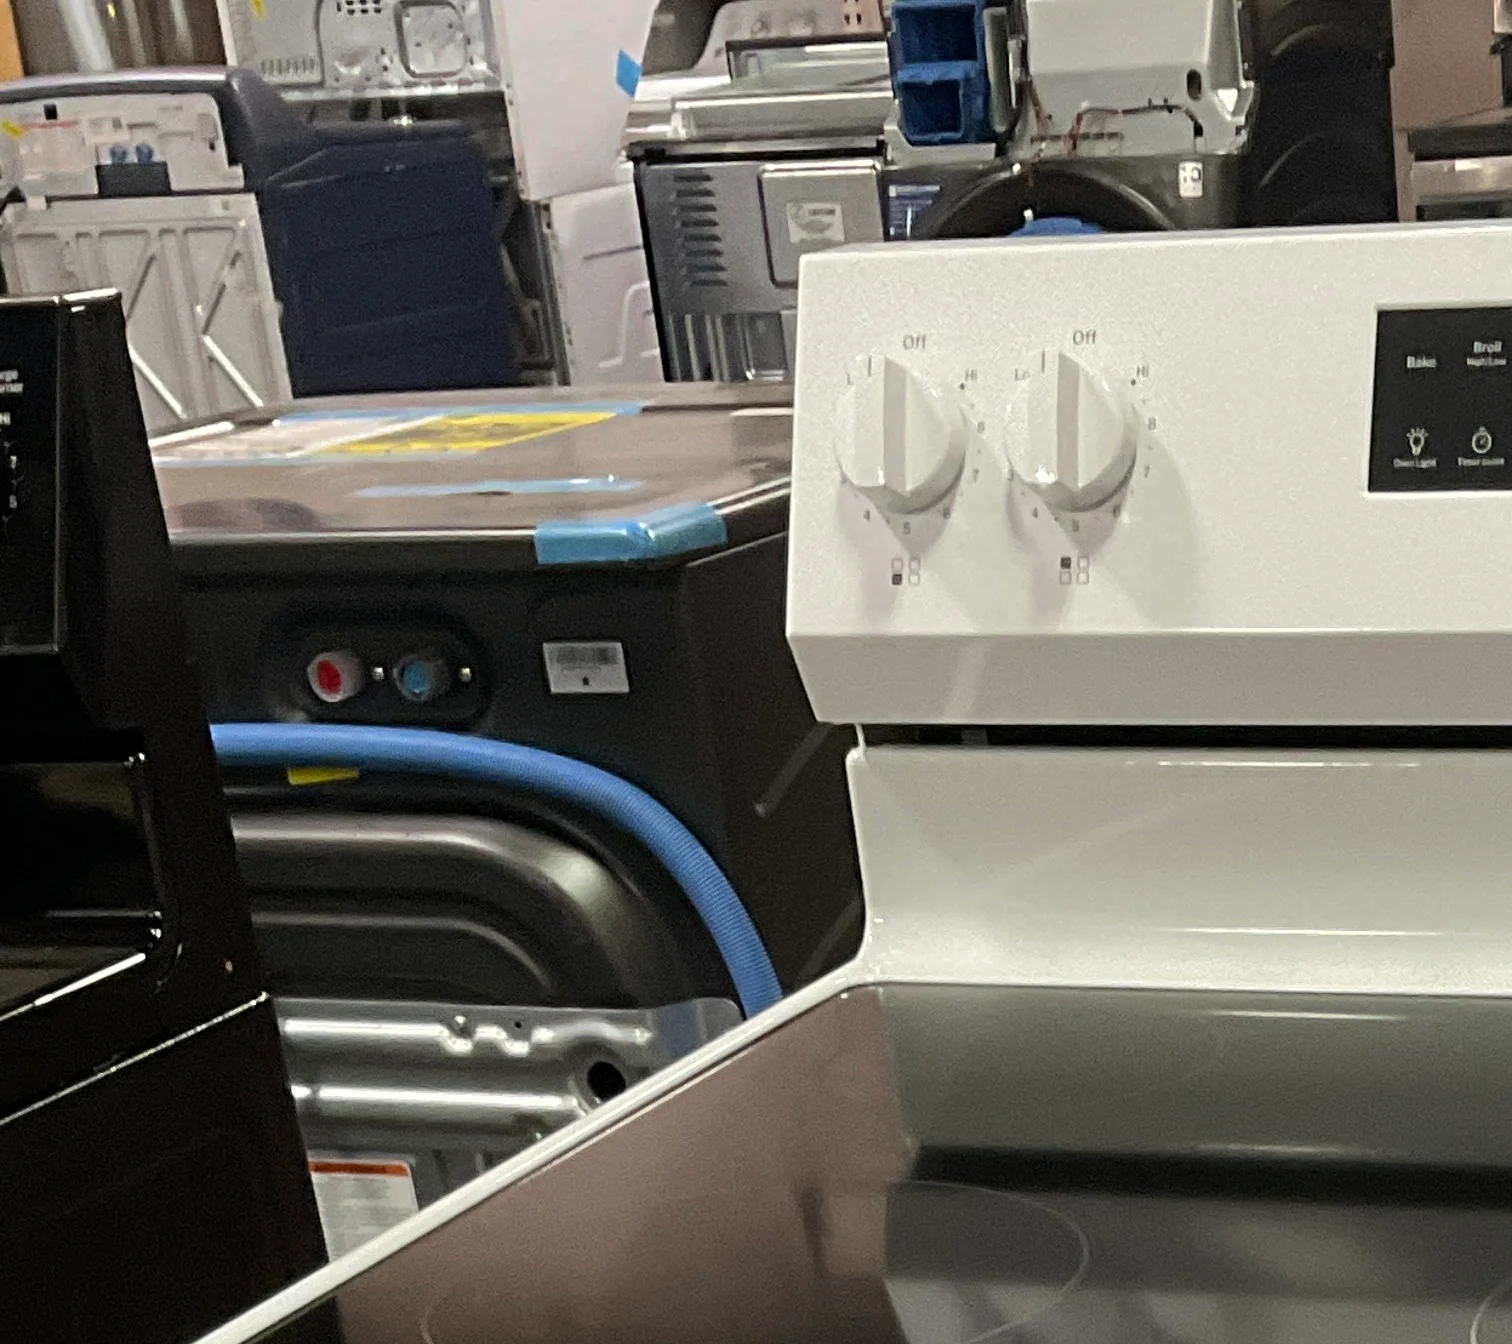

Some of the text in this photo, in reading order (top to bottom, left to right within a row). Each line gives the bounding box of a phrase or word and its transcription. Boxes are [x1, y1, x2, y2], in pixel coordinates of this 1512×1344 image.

[902, 333, 927, 350] Off
[1072, 329, 1097, 346] Off
[1472, 340, 1502, 354] Broil
[1406, 355, 1437, 369] Bake
